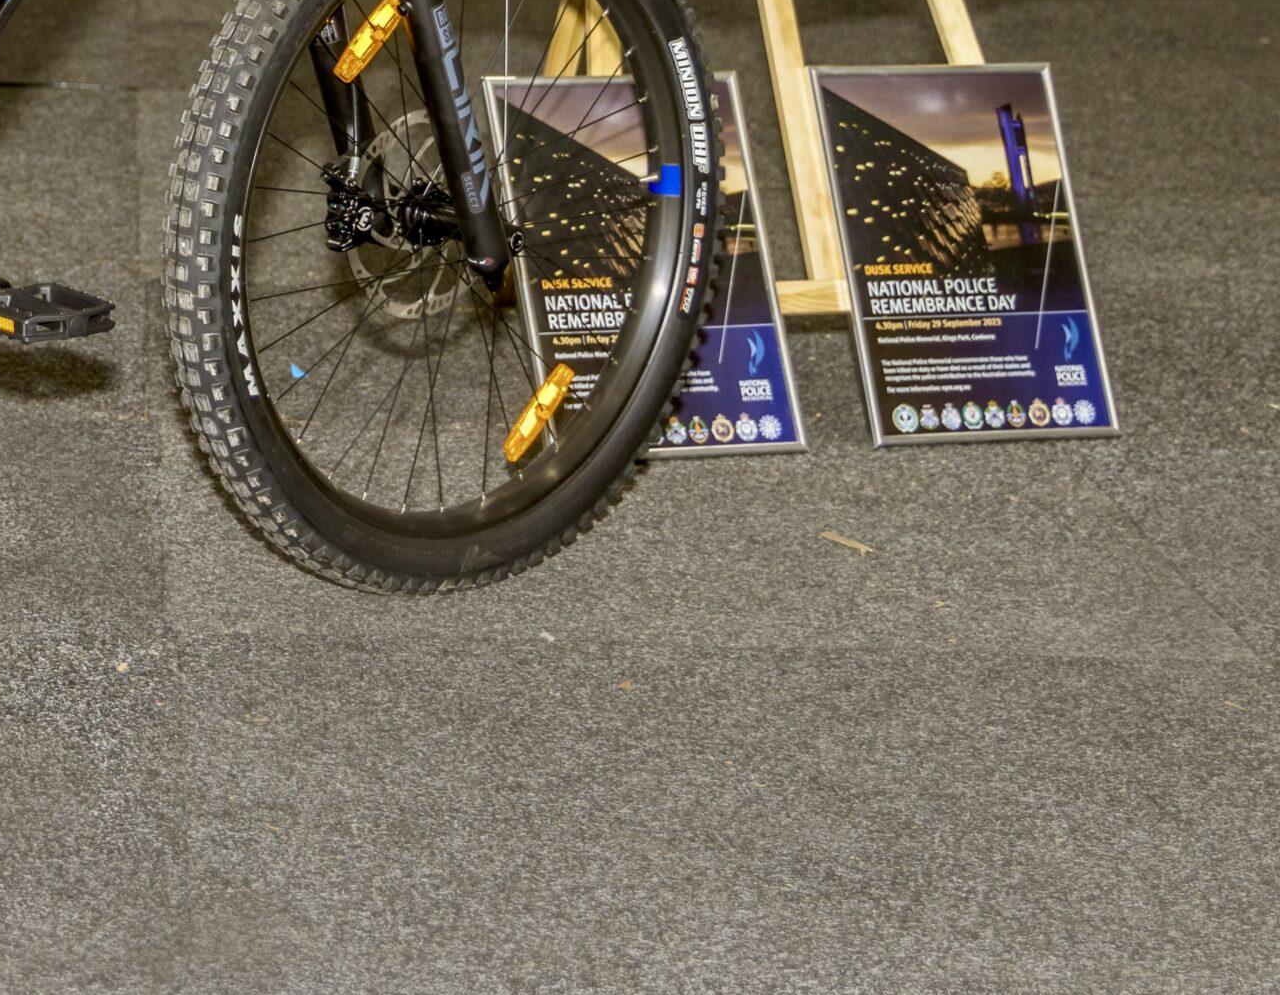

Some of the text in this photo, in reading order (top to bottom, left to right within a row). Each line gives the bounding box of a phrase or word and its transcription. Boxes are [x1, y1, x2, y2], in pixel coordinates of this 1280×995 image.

[669, 37, 709, 174] MINION DHF
[463, 174, 481, 209] SELECT
[865, 263, 932, 275] DUSK SERVICE
[571, 277, 612, 288] SERVICE
[867, 277, 996, 296] NATIONAL POLICE
[231, 214, 259, 395] MAXXIS
[545, 294, 622, 311] NATIONAL
[871, 295, 1016, 314] REMEMBRANCE DAY
[548, 311, 625, 328] REMEMBR
[908, 320, 930, 330] Friday
[943, 319, 981, 329] September
[1056, 372, 1086, 381] POLICE
[741, 385, 772, 396] POLICE
